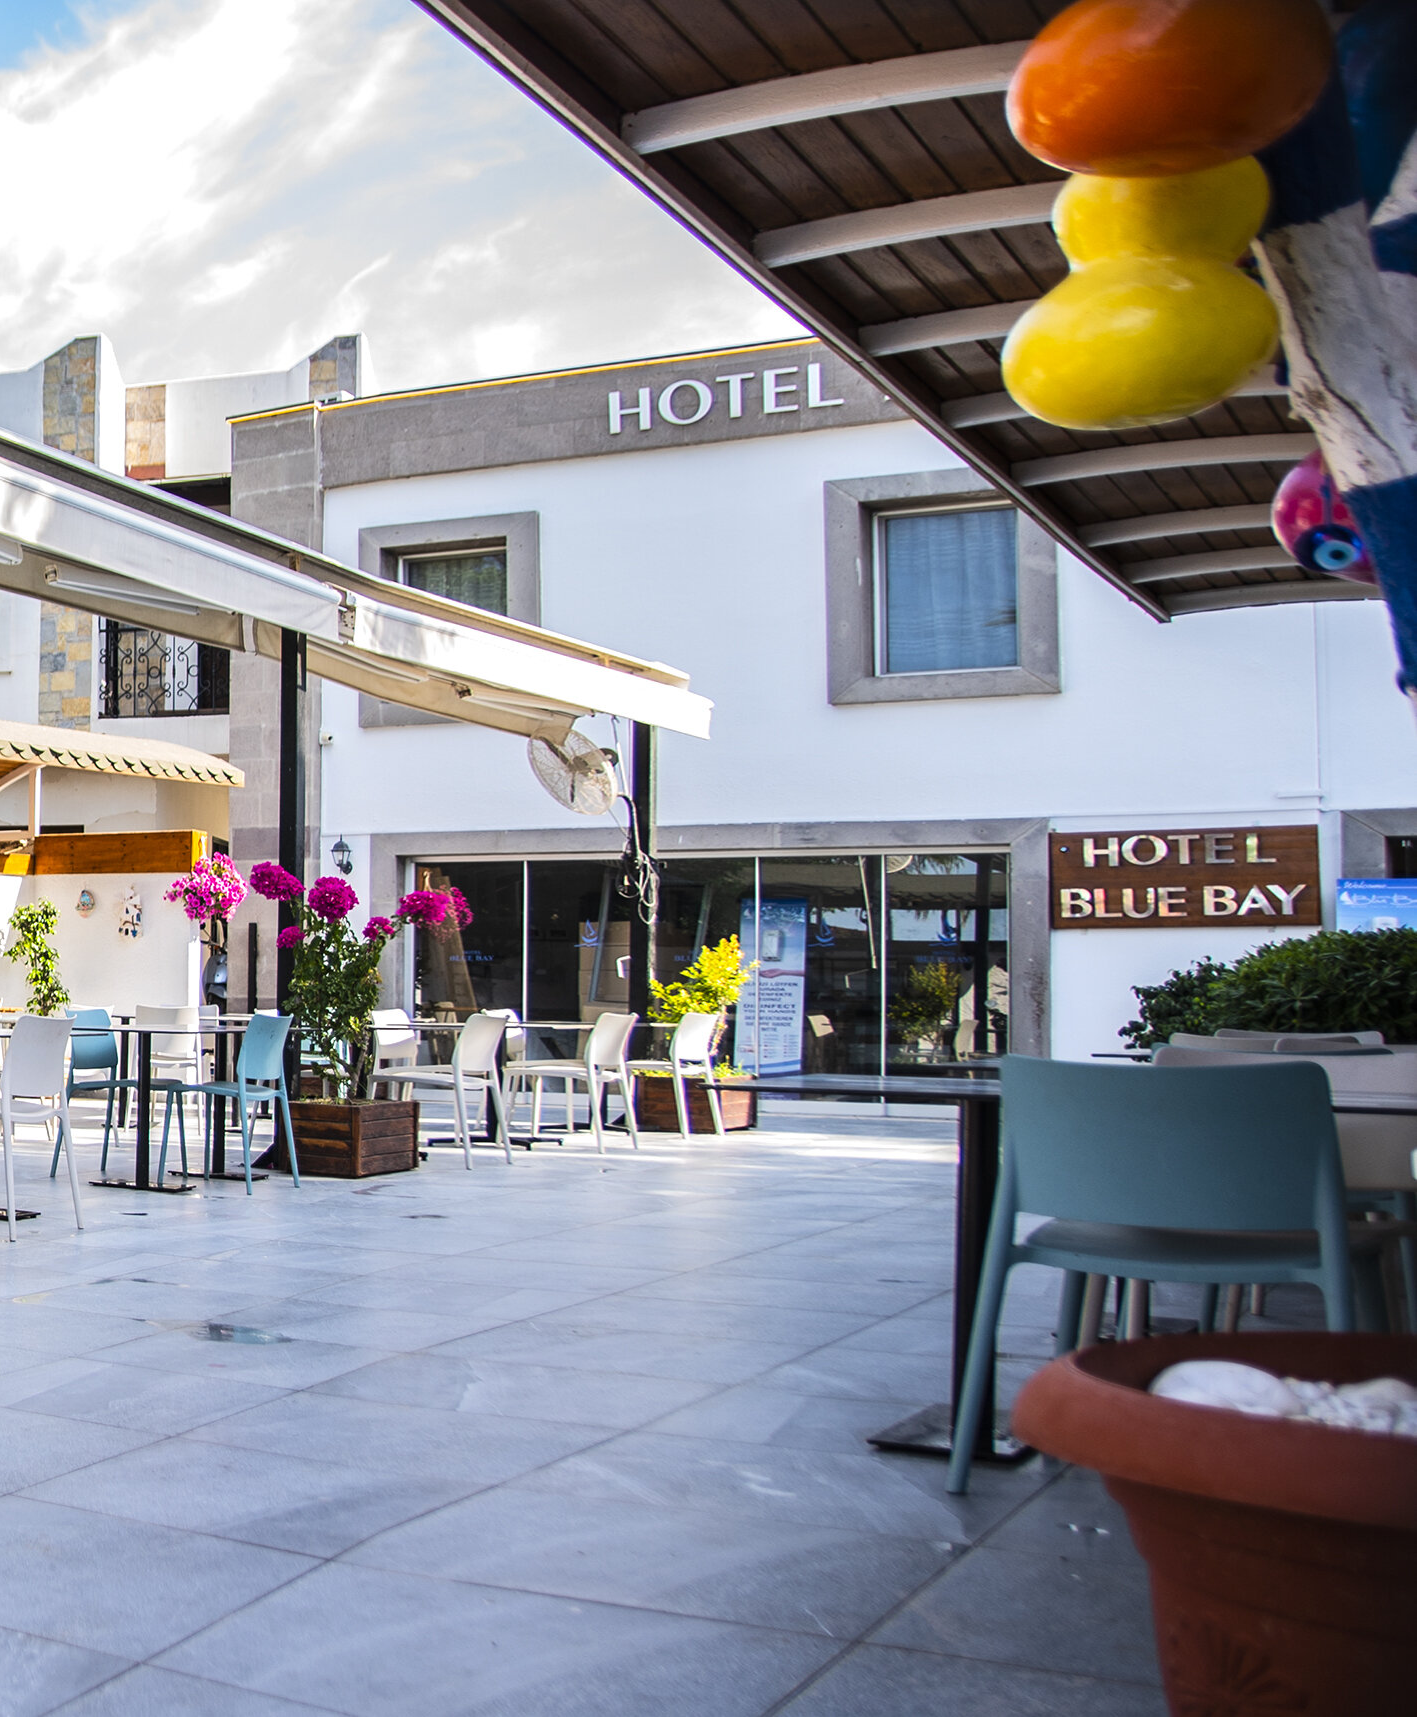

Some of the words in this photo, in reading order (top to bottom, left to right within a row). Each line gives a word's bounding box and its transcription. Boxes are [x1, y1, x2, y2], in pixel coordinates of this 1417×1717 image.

[608, 363, 845, 434] HOTEL
[1083, 833, 1277, 868] HOTEL
[1060, 886, 1187, 919] BLUE
[1202, 884, 1307, 916] BAY
